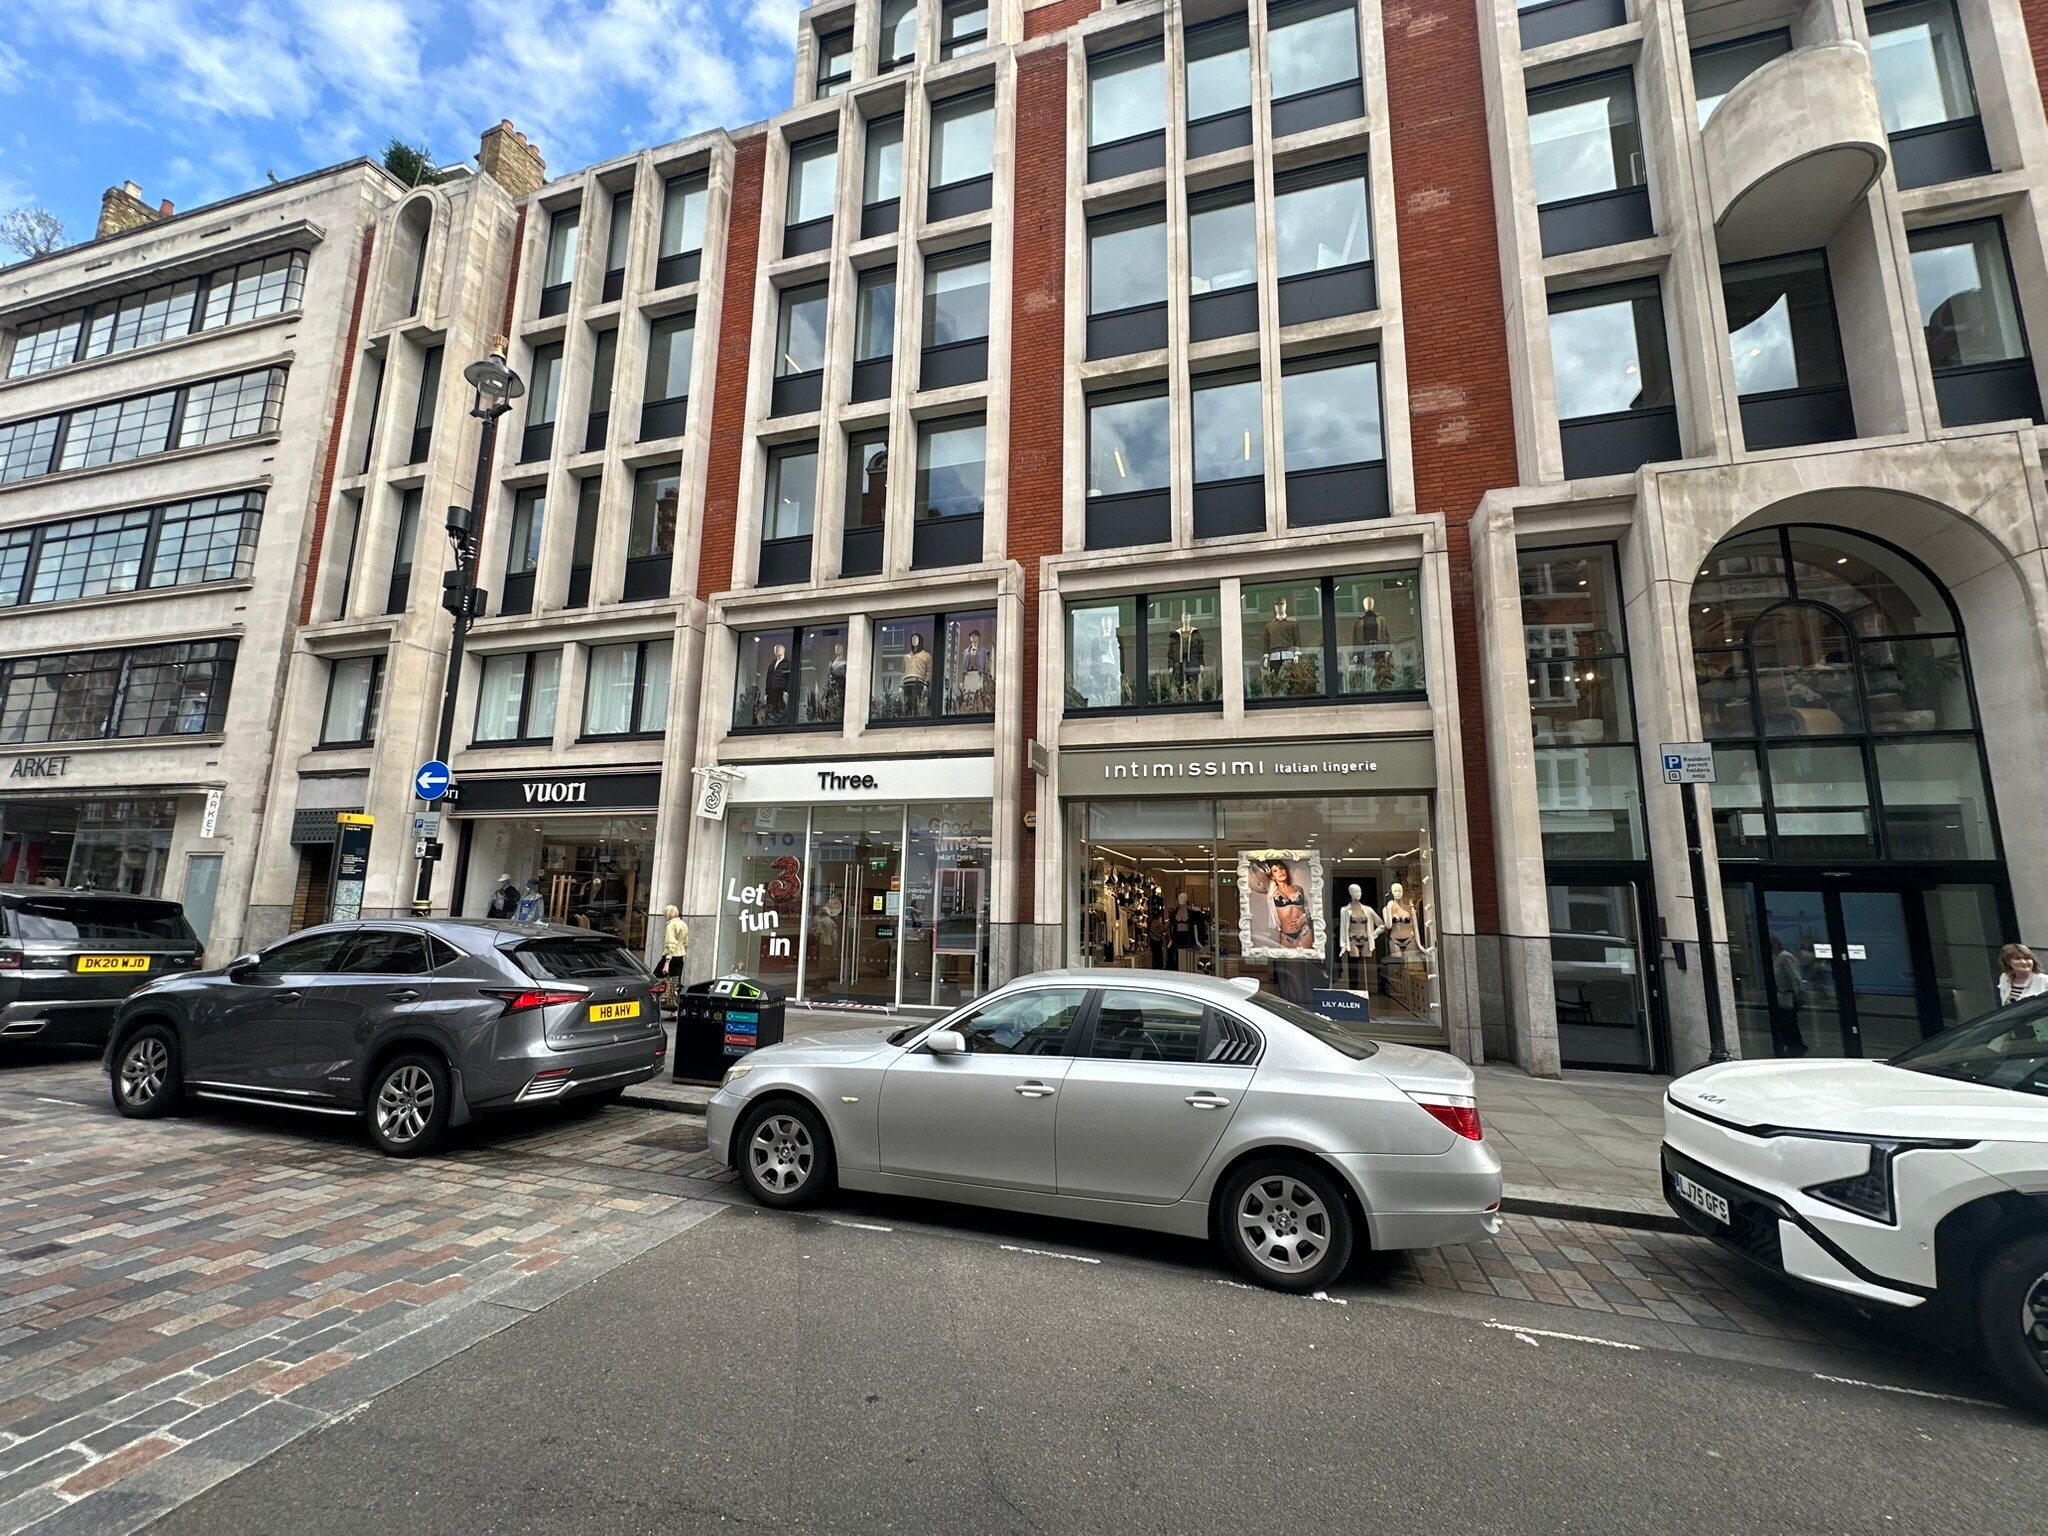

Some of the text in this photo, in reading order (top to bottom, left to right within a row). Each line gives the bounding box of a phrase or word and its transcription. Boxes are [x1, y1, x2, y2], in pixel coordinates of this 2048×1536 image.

[10, 756, 71, 778] ARKET
[1105, 761, 1378, 778] intimissimi Italian lingerie
[817, 771, 878, 790] Three.
[205, 791, 219, 837] ARKET
[727, 877, 766, 906] Let
[739, 909, 779, 933] fun
[769, 932, 791, 956] in
[85, 958, 145, 968] DK20 WJD
[600, 1005, 631, 1018] H8 AHV
[1337, 1001, 1360, 1009] ALLEN
[1680, 1176, 1727, 1220] LJ75 GFS
